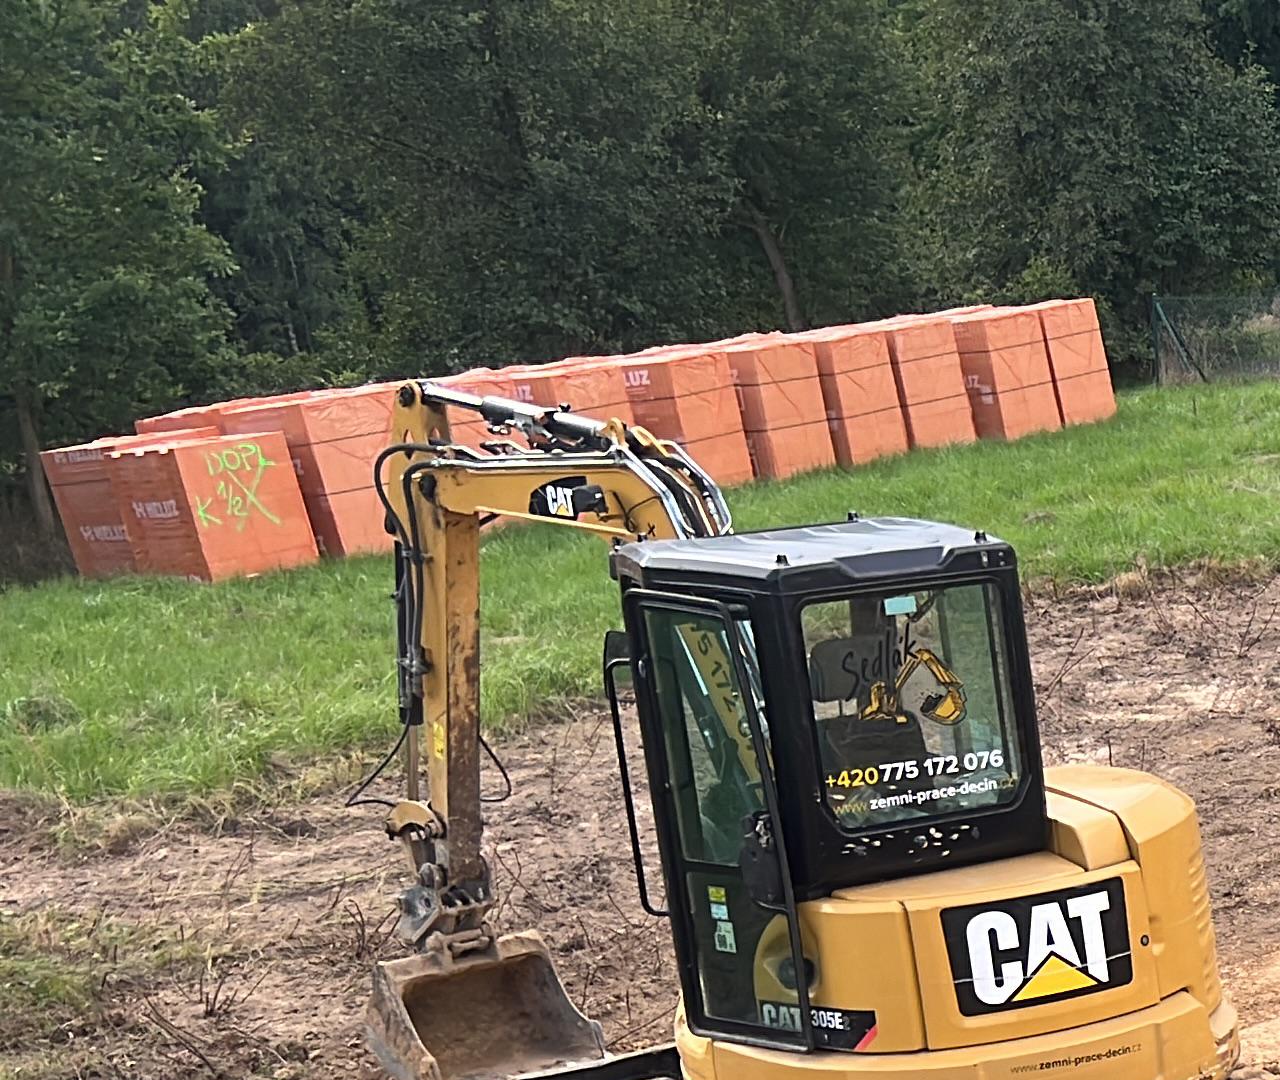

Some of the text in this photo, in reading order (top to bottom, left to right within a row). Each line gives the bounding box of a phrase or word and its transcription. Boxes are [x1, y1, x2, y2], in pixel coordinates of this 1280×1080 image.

[624, 369, 650, 387] LUZ
[546, 484, 575, 517] CAT
[825, 749, 1004, 789] +420 775 172 076
[966, 891, 1110, 1005] CAT
